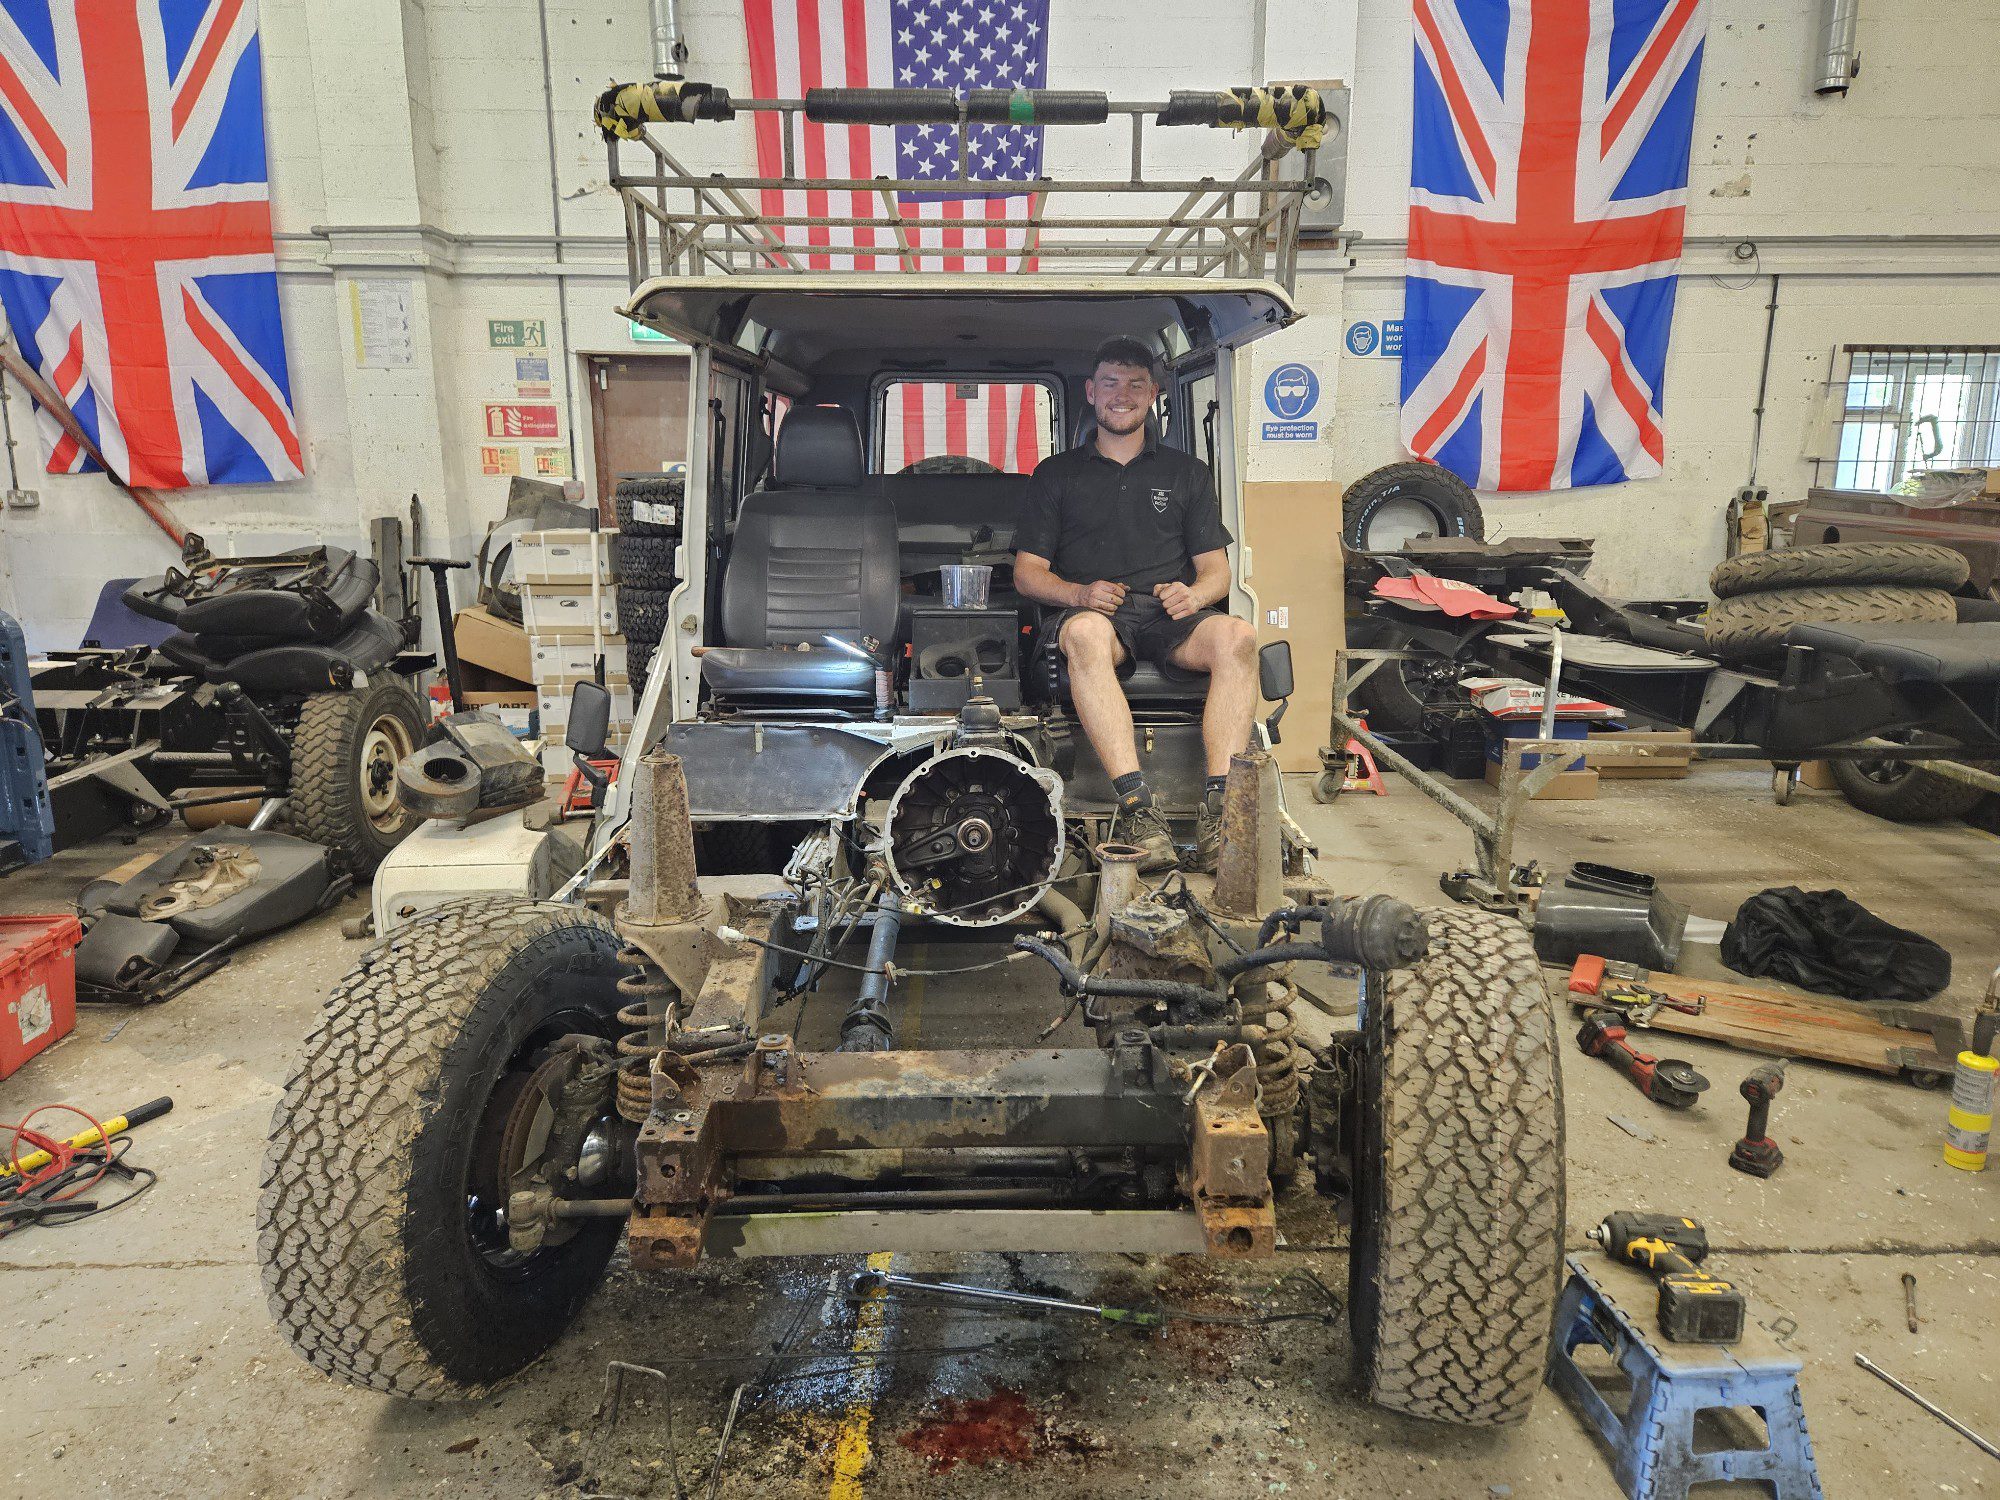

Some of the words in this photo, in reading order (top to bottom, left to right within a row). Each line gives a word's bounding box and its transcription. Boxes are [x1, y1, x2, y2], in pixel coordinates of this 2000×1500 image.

[493, 322, 514, 333] Fire
[1386, 324, 1404, 332] Mas
[495, 335, 515, 345] exit
[1380, 485, 1401, 497] T/A
